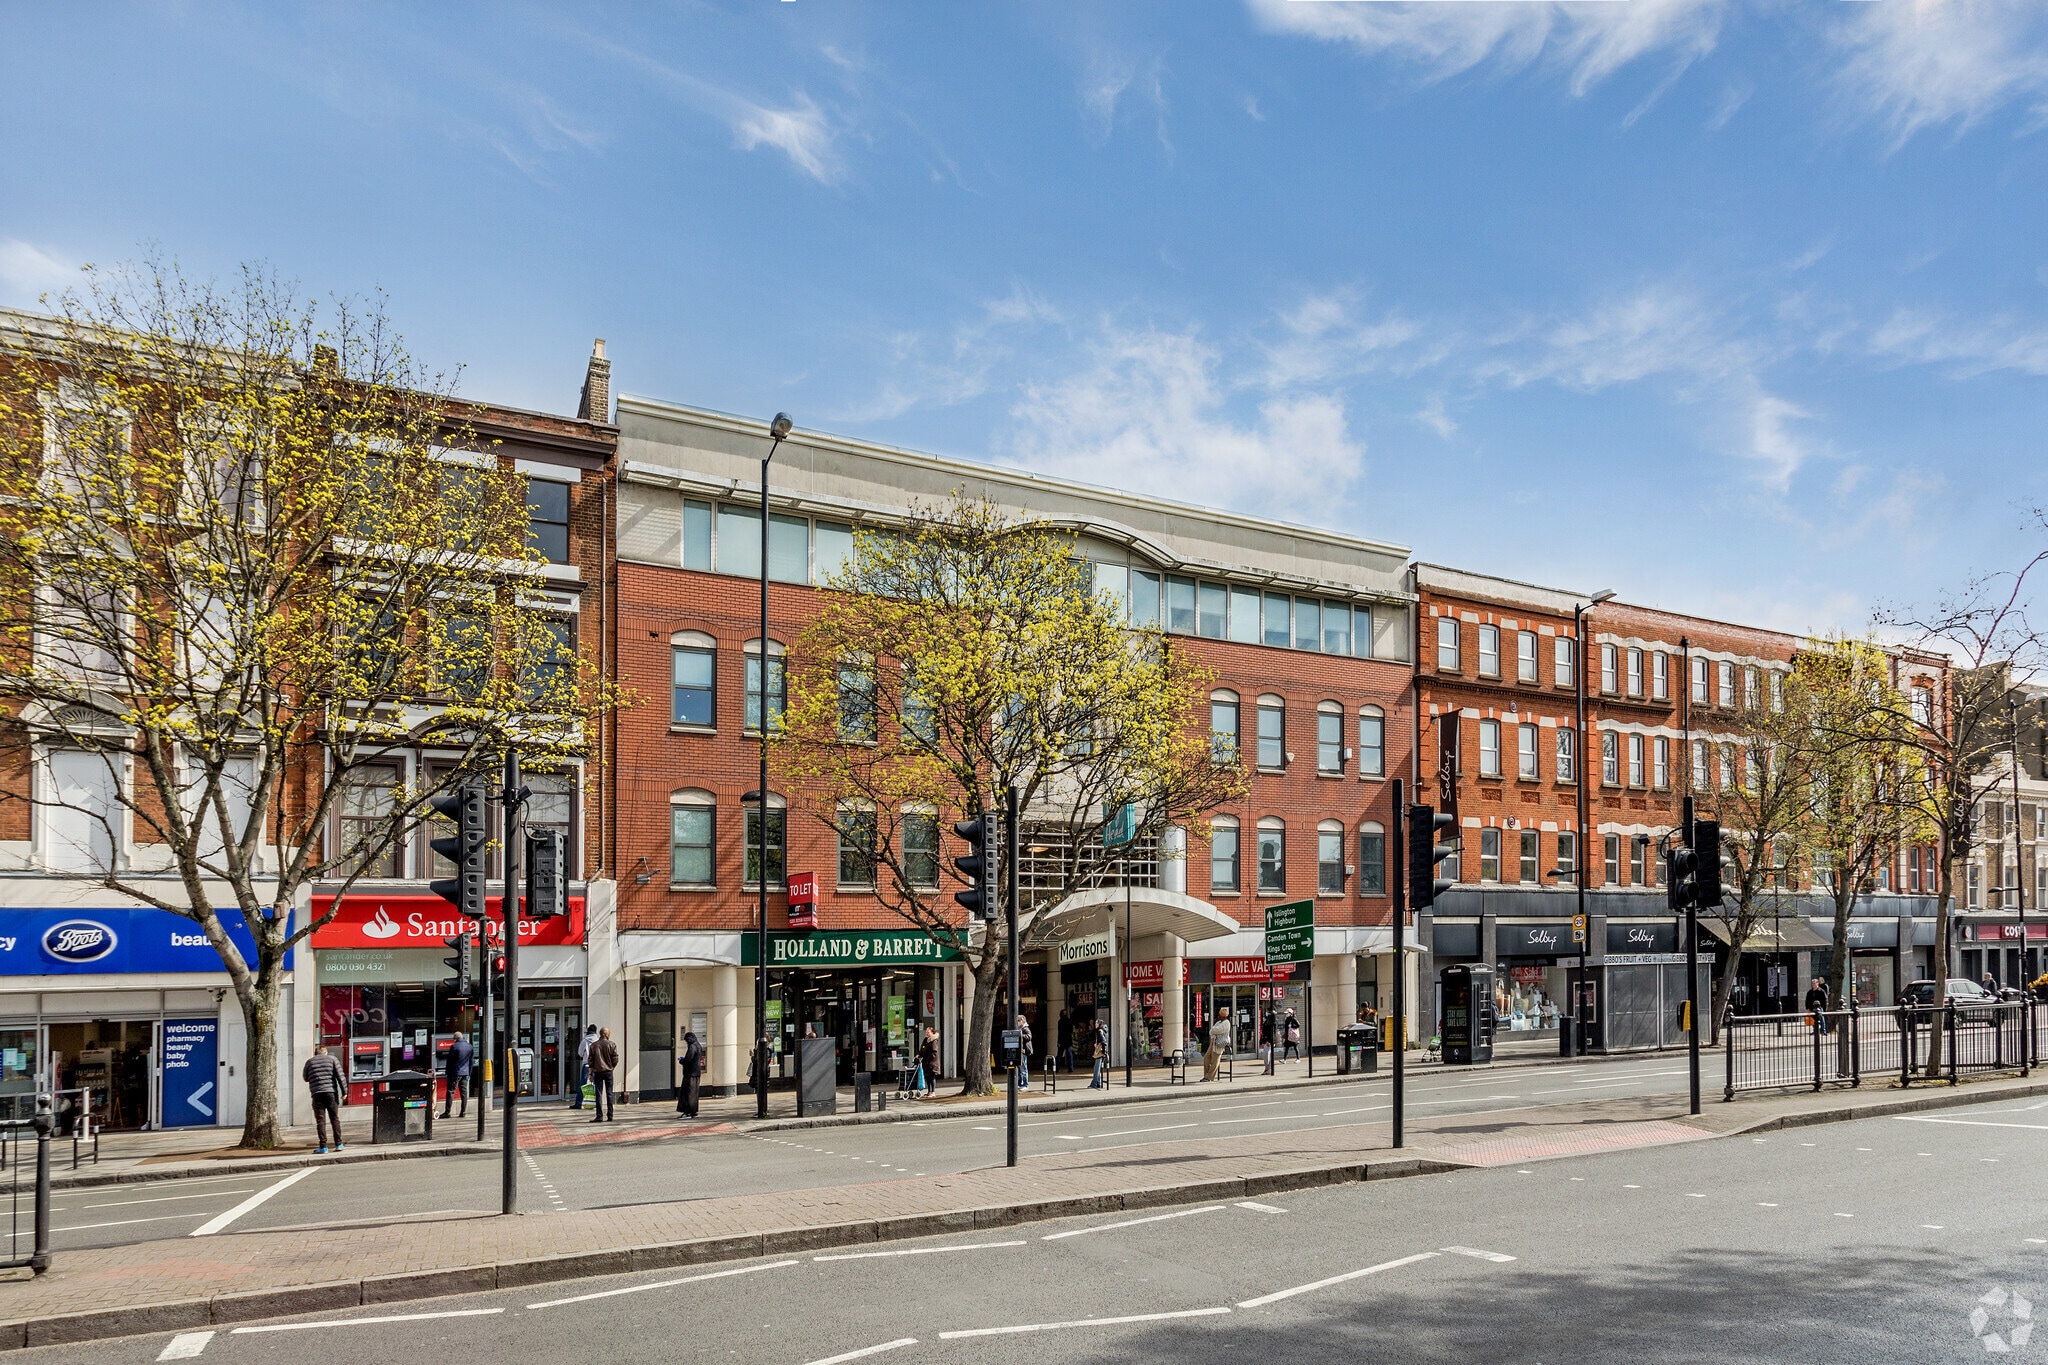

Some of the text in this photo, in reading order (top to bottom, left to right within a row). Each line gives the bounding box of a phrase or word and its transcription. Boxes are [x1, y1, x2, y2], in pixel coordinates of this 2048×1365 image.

[790, 885, 799, 896] TO
[800, 882, 812, 895] LET
[1274, 917, 1296, 926] Highbury
[52, 929, 104, 952] Boots
[1267, 934, 1286, 942] Camden
[1527, 929, 1557, 950] Selbys
[1627, 929, 1654, 948] Selbys
[773, 938, 943, 960] HOLLAND & BARRETT
[1060, 939, 1108, 961] Morrisons
[1267, 945, 1280, 953] Kings
[326, 952, 393, 960] santander.co.uk
[1267, 953, 1291, 962] Barnsbury
[1604, 955, 1623, 963] GIBBO'S
[1623, 955, 1637, 963] FRUIT
[1642, 955, 1652, 963] VEG
[325, 963, 347, 971] 0800
[349, 963, 365, 971] 030
[1220, 961, 1249, 974] HOME
[640, 984, 668, 1001] 406
[166, 1024, 215, 1033] welcome
[166, 1035, 205, 1043] pharmacy
[166, 1052, 186, 1060] baby
[166, 1061, 189, 1069] photo
